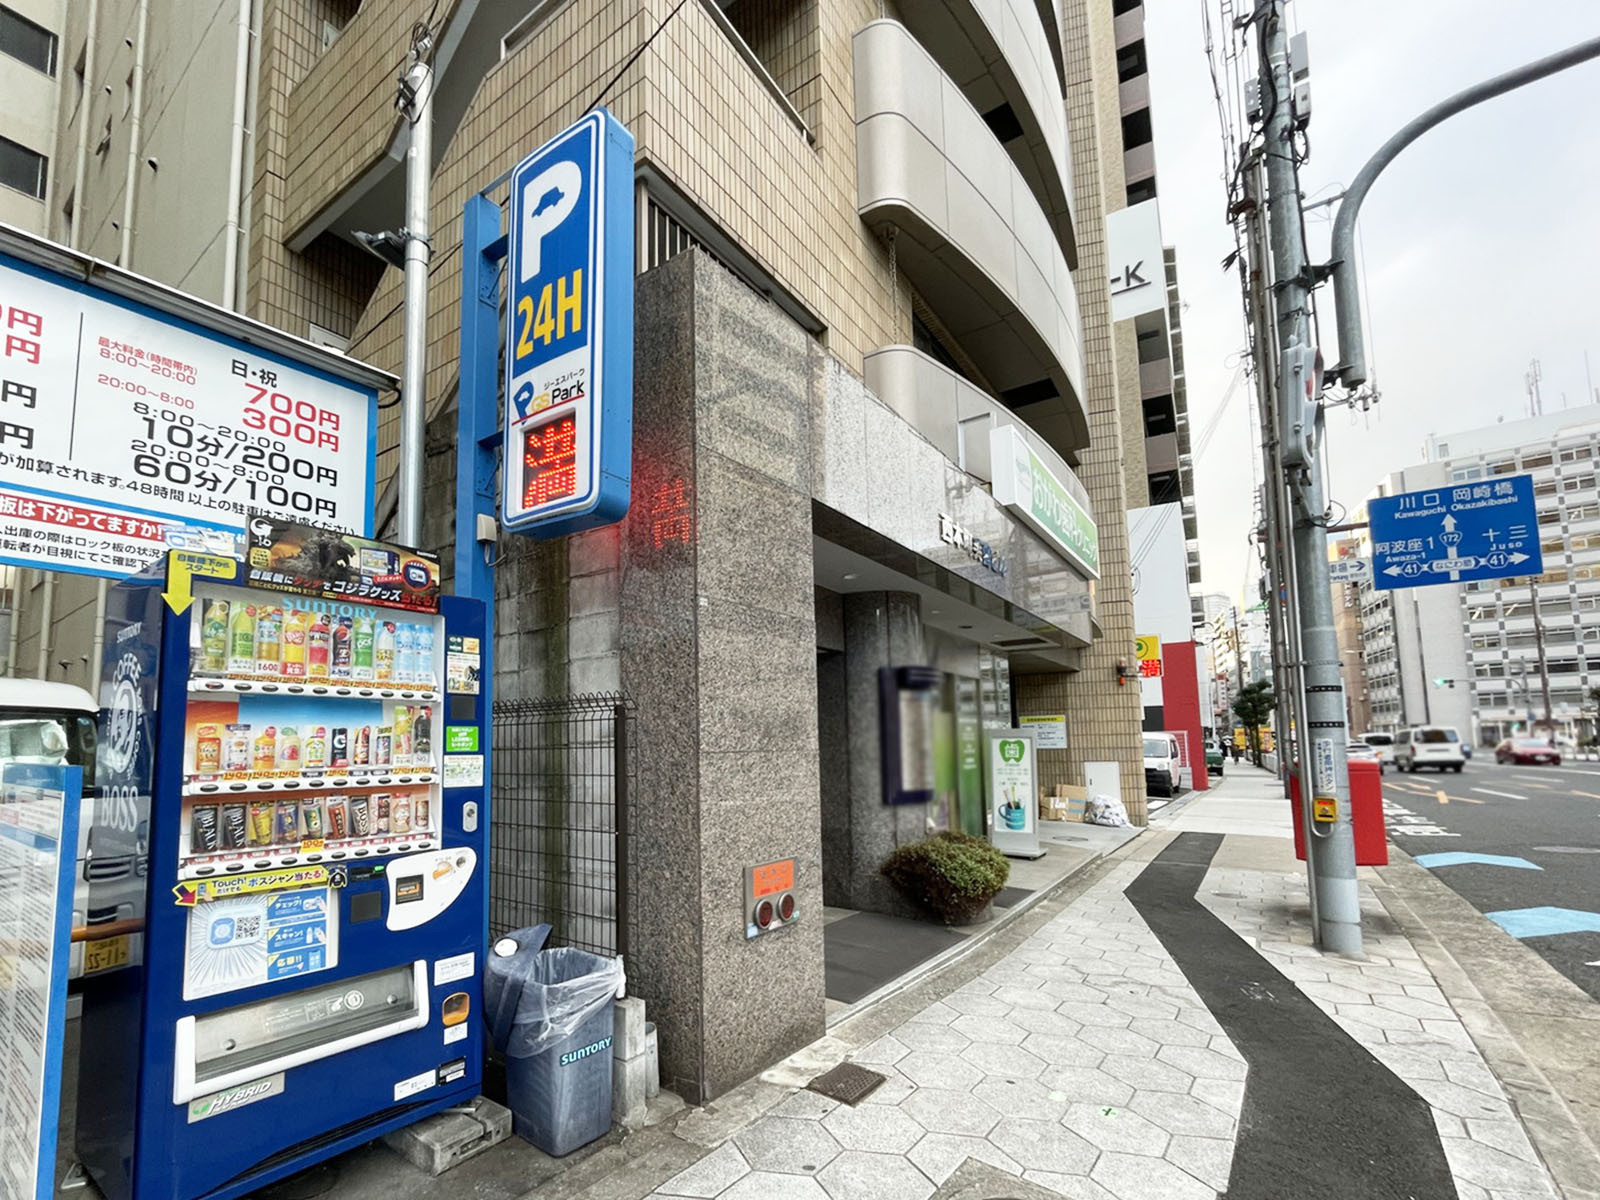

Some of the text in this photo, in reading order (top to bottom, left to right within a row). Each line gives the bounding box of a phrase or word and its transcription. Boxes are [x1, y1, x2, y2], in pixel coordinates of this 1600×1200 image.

[521, 160, 583, 285] P
[0, 304, 42, 337] 円
[515, 268, 583, 361] 24H
[5, 334, 41, 365] 円
[231, 359, 277, 389] 日・祝
[543, 367, 585, 391] ジーエスパーク
[1, 379, 37, 409] 円
[552, 379, 585, 405] Park
[244, 382, 340, 432] 700円
[0, 421, 34, 450] 円
[242, 407, 339, 453] 300円
[1394, 495, 1518, 520] Kawaguchi Okazakibashi
[1400, 482, 1514, 510] 川口 岡崎橋
[1442, 534, 1459, 542] 172
[1482, 524, 1528, 542] 十三
[1404, 564, 1418, 574] 41
[1489, 554, 1505, 565] 41
[282, 597, 377, 620] SUNTORY
[100, 785, 138, 832] BOSS
[212, 876, 247, 888] Touch!
[561, 1037, 612, 1066] SUNTORY
[208, 1081, 272, 1115] HYBRID
